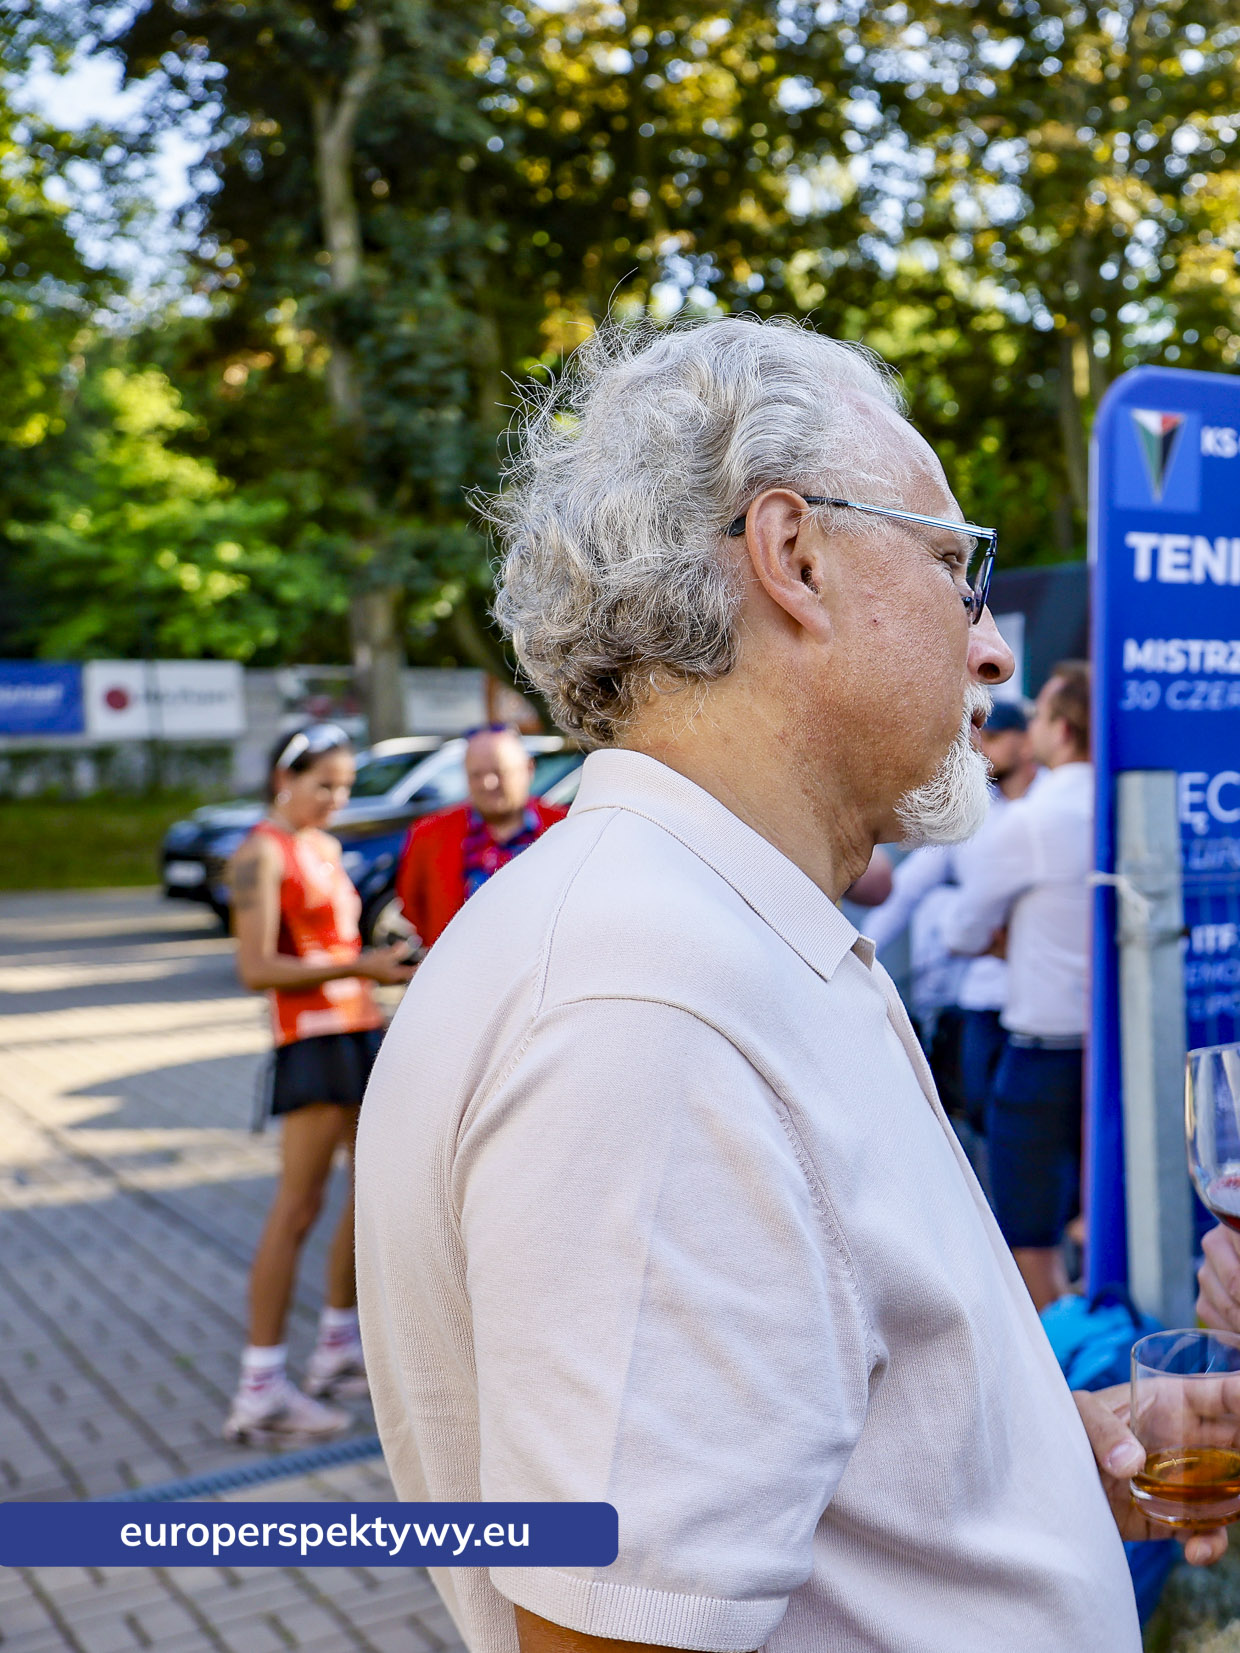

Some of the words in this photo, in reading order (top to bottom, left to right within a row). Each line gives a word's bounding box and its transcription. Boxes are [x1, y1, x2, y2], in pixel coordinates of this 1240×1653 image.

[1201, 425, 1238, 459] KS
[1120, 680, 1161, 711] 30
[1191, 922, 1238, 953] ITF
